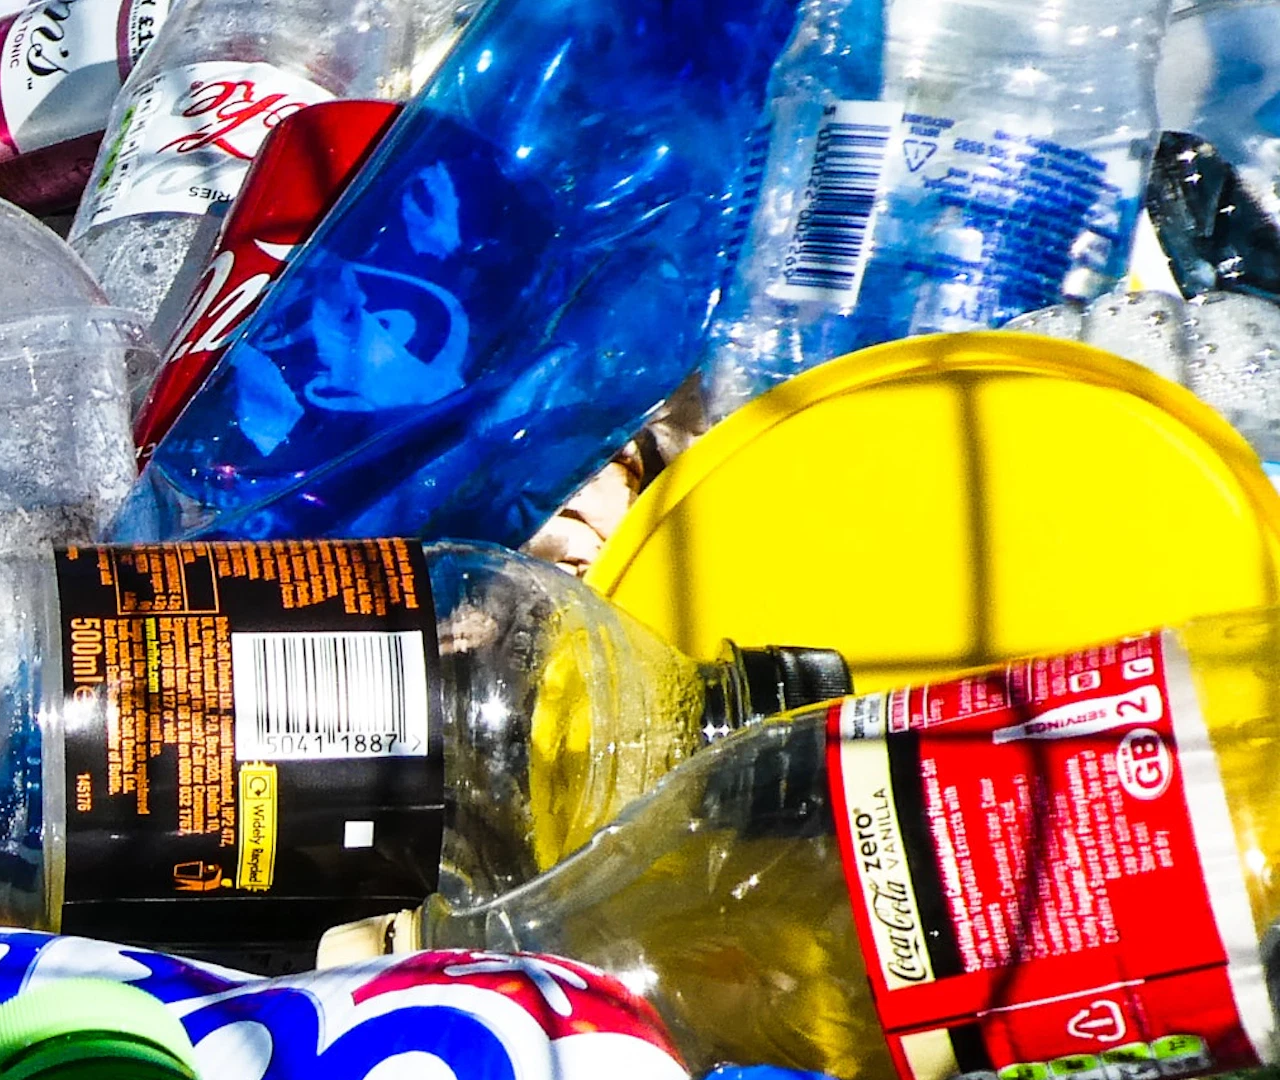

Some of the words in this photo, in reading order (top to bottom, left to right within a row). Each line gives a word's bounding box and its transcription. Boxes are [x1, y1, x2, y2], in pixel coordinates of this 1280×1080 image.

[10, 25, 27, 69] TONIC
[70, 617, 103, 682] 500ml
[217, 641, 230, 659] Soft
[219, 660, 231, 690] Drinks
[1117, 694, 1150, 719] 2
[340, 733, 398, 754] 1887
[1123, 737, 1169, 794] GB
[76, 773, 91, 811] 145176
[251, 803, 265, 844] Widely
[852, 811, 882, 873] zero
[870, 787, 900, 869] VANILLA
[247, 847, 263, 882] Recycled
[868, 876, 927, 986] Coca-Cola
